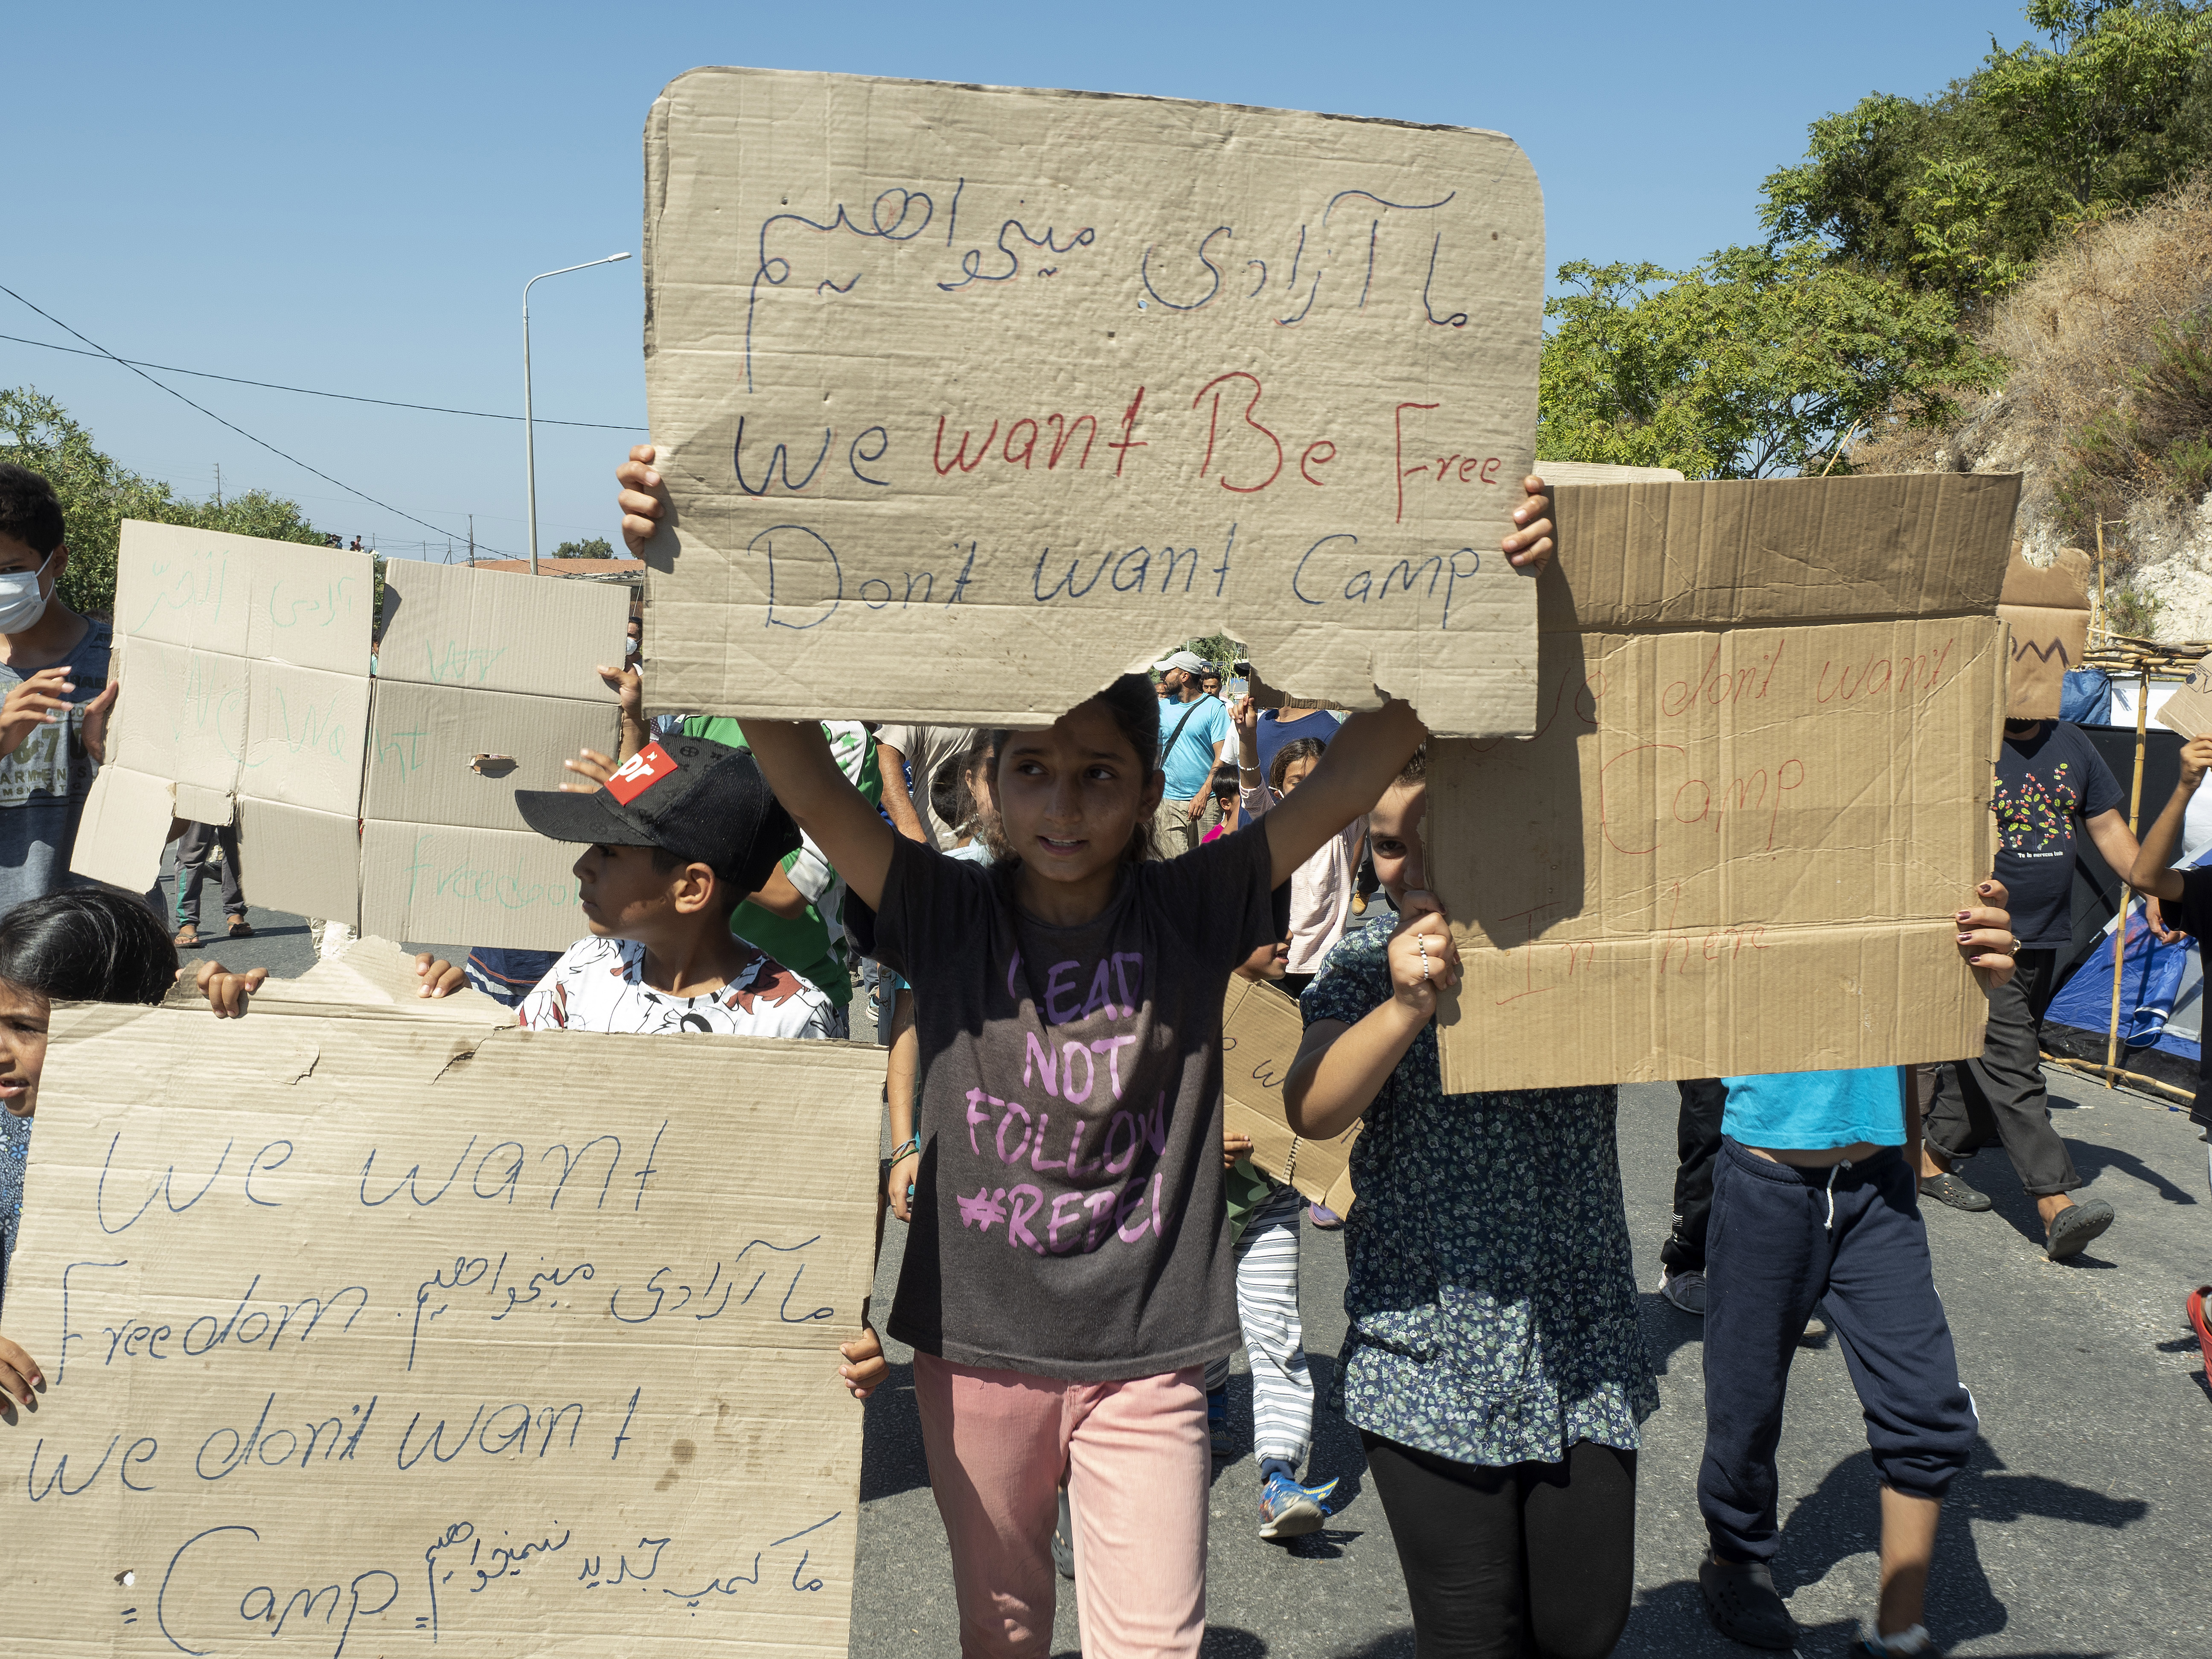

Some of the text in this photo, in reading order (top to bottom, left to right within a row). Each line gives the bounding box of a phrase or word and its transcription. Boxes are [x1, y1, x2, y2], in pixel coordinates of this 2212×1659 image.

[1425, 232, 1468, 327] ما
[735, 371, 1501, 523] We want Be Free
[1032, 522, 1237, 601] want
[1293, 534, 1480, 629] Camp
[1600, 744, 1804, 854] Camp
[1024, 1032, 1136, 1104] NOT
[98, 1120, 668, 1234] We want
[56, 1260, 368, 1385] Freedom
[780, 1263, 834, 1323] ما
[29, 1434, 158, 1502] We
[398, 1386, 641, 1470] want
[157, 1525, 399, 1659] Camp
[792, 1548, 824, 1591] ما
